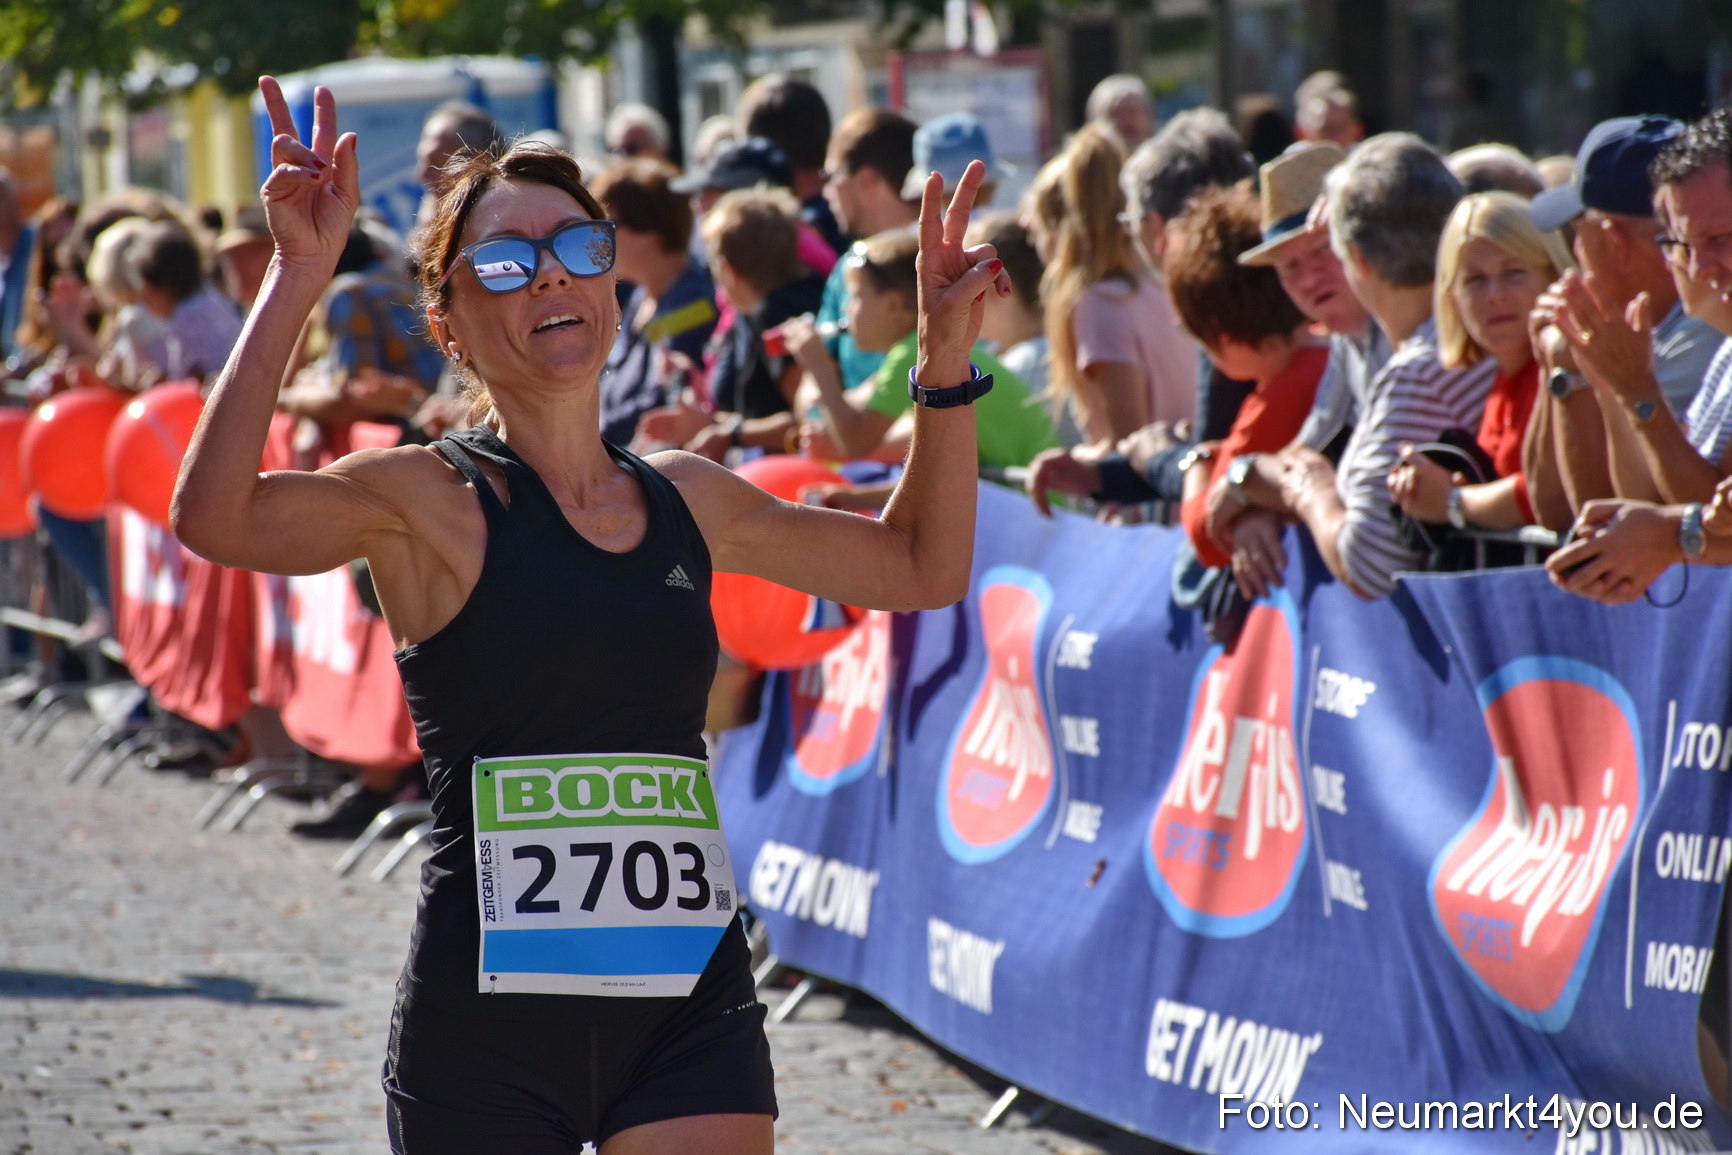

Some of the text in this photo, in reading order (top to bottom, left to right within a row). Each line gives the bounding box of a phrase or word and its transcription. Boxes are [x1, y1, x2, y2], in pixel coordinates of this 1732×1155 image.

[665, 578, 695, 590] adidas
[495, 765, 707, 822] BOCK
[512, 840, 710, 914] 2703
[1446, 757, 1628, 947] hervis
